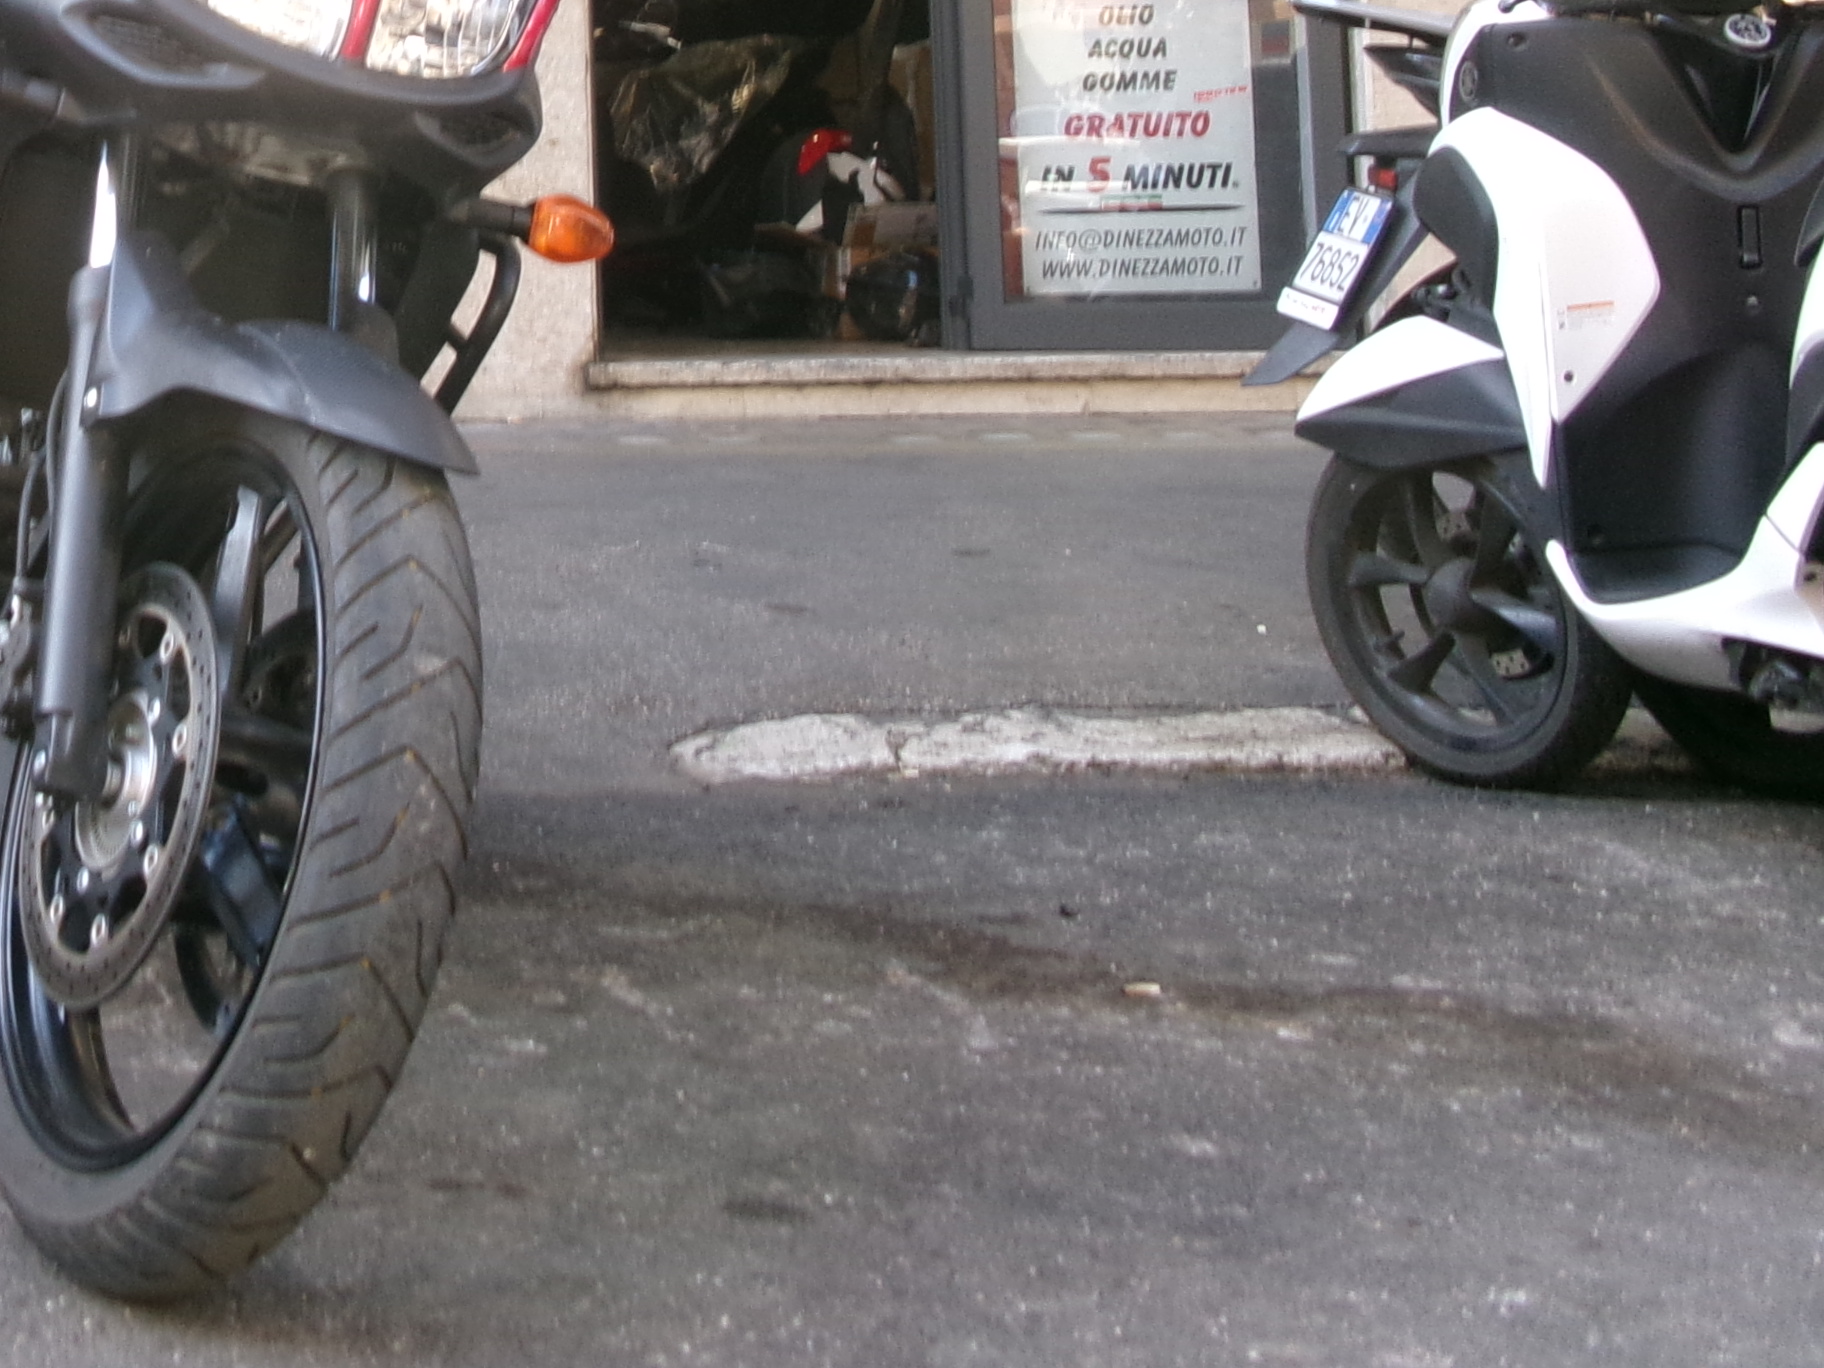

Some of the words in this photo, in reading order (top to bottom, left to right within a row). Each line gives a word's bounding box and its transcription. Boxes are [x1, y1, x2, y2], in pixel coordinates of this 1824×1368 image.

[1097, 3, 1155, 26] OLIO
[1087, 36, 1168, 60] ACQUA
[1082, 69, 1179, 93] GOMME
[1063, 110, 1211, 139] GRATUITO
[1040, 163, 1075, 192] IN
[1086, 155, 1112, 193] 5
[1034, 225, 1248, 252] INFO@DINEZZAMOTO.IT
[1041, 255, 1244, 281] WWW.DINEZZAMOTO.IT
[1298, 242, 1360, 292] 76852
